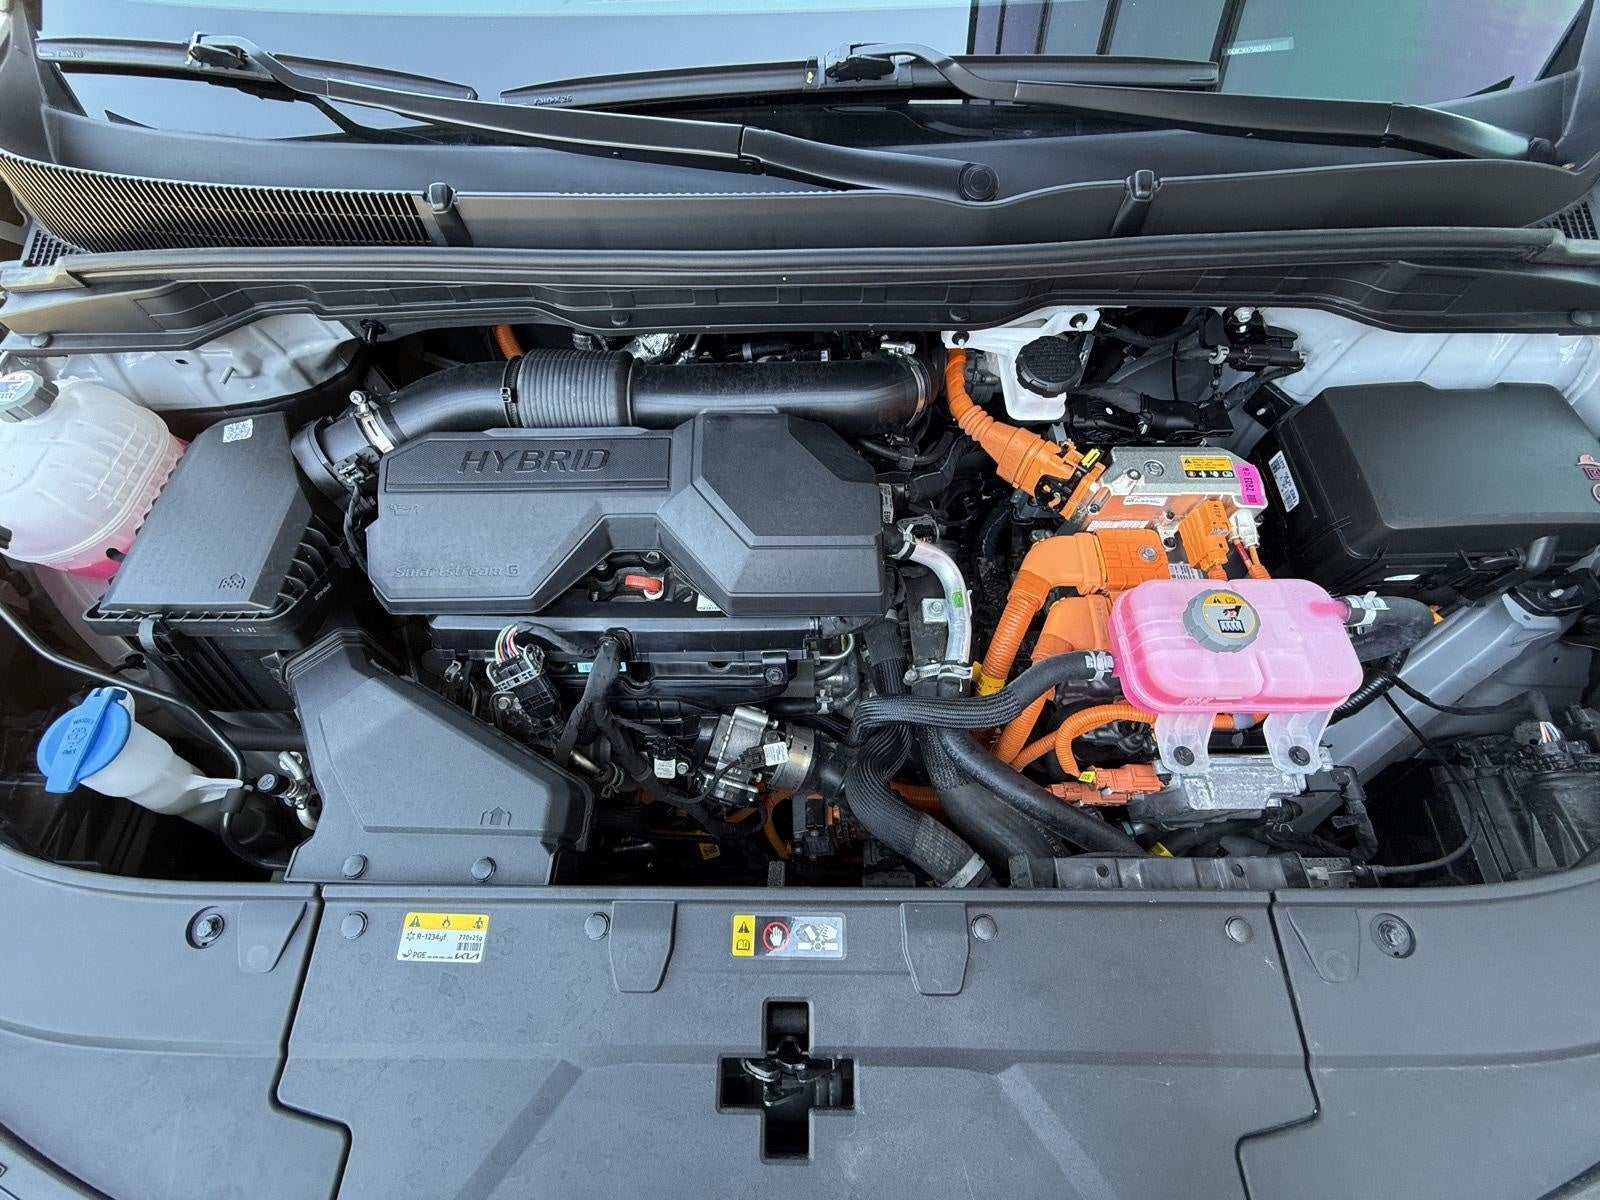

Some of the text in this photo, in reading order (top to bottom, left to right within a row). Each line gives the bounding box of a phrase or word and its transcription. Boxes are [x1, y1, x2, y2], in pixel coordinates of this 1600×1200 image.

[456, 449, 611, 473] HYBRID
[394, 563, 520, 578] Smartstream G
[416, 933, 447, 942] R-1234yf
[412, 951, 427, 959] POE
